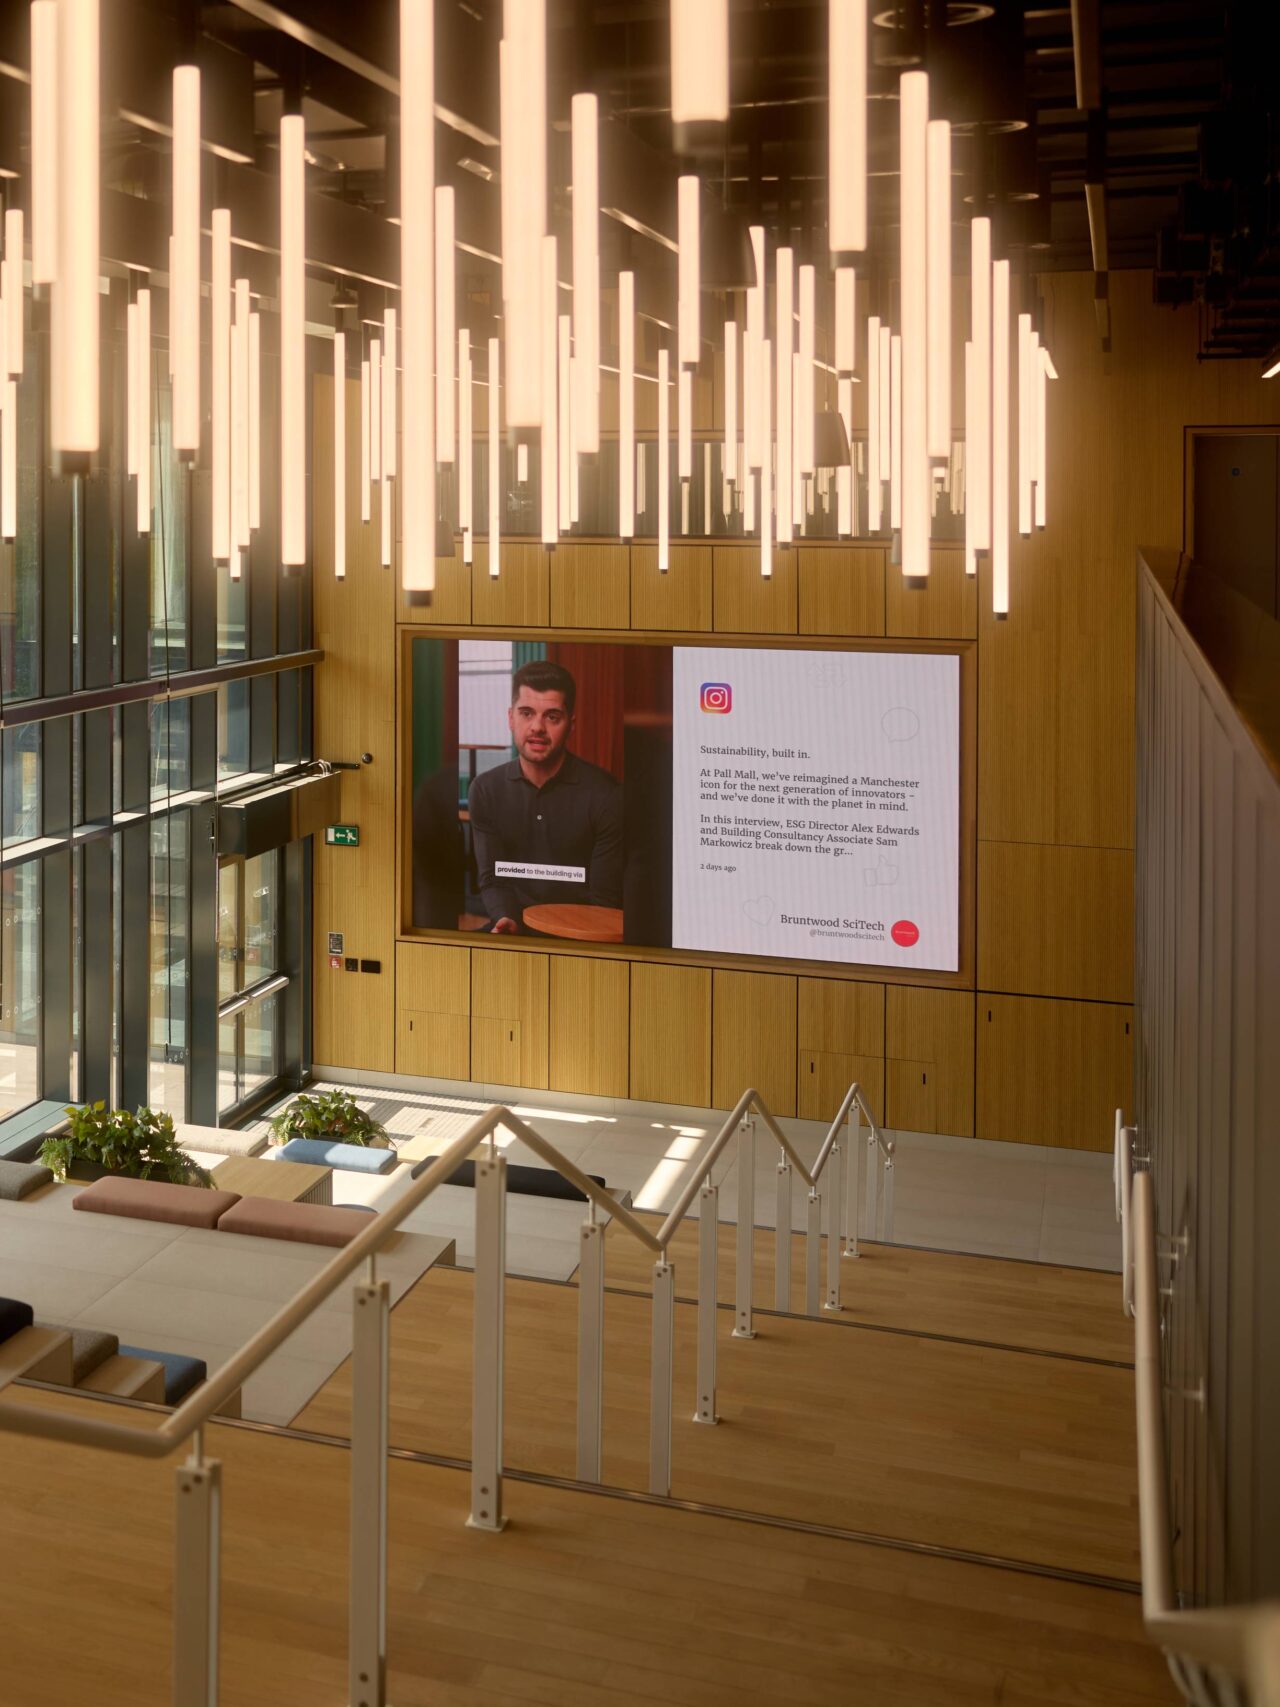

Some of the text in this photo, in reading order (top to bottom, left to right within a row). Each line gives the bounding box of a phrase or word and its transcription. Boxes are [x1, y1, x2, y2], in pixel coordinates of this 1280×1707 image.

[700, 745, 810, 759] Sustainability, built in.
[700, 769, 711, 778] At
[714, 769, 731, 778] Pall
[734, 770, 759, 781] Mall,
[762, 772, 790, 781] we’ve
[793, 773, 849, 785] reimagined
[861, 777, 920, 788] Manchester
[701, 781, 720, 789] icon
[724, 781, 737, 790] for
[740, 782, 756, 791] the
[759, 784, 780, 793] next
[783, 785, 835, 796] generation
[839, 787, 849, 796] of
[852, 788, 906, 799] innovators
[700, 792, 908, 811] and we’ve done it with the planet in mind.
[700, 815, 919, 836] In this interview, ESG Director Alex Edwards
[700, 826, 898, 846] and Building Consultancy Associate Sam
[700, 838, 752, 849] Markowicz
[755, 839, 782, 850] break
[785, 842, 812, 852] down
[815, 844, 831, 854] the
[546, 870, 572, 878] building
[706, 863, 722, 872] days
[781, 914, 884, 931] Bruntwood SciTech
[809, 929, 884, 940] @bruntwoodscitech
